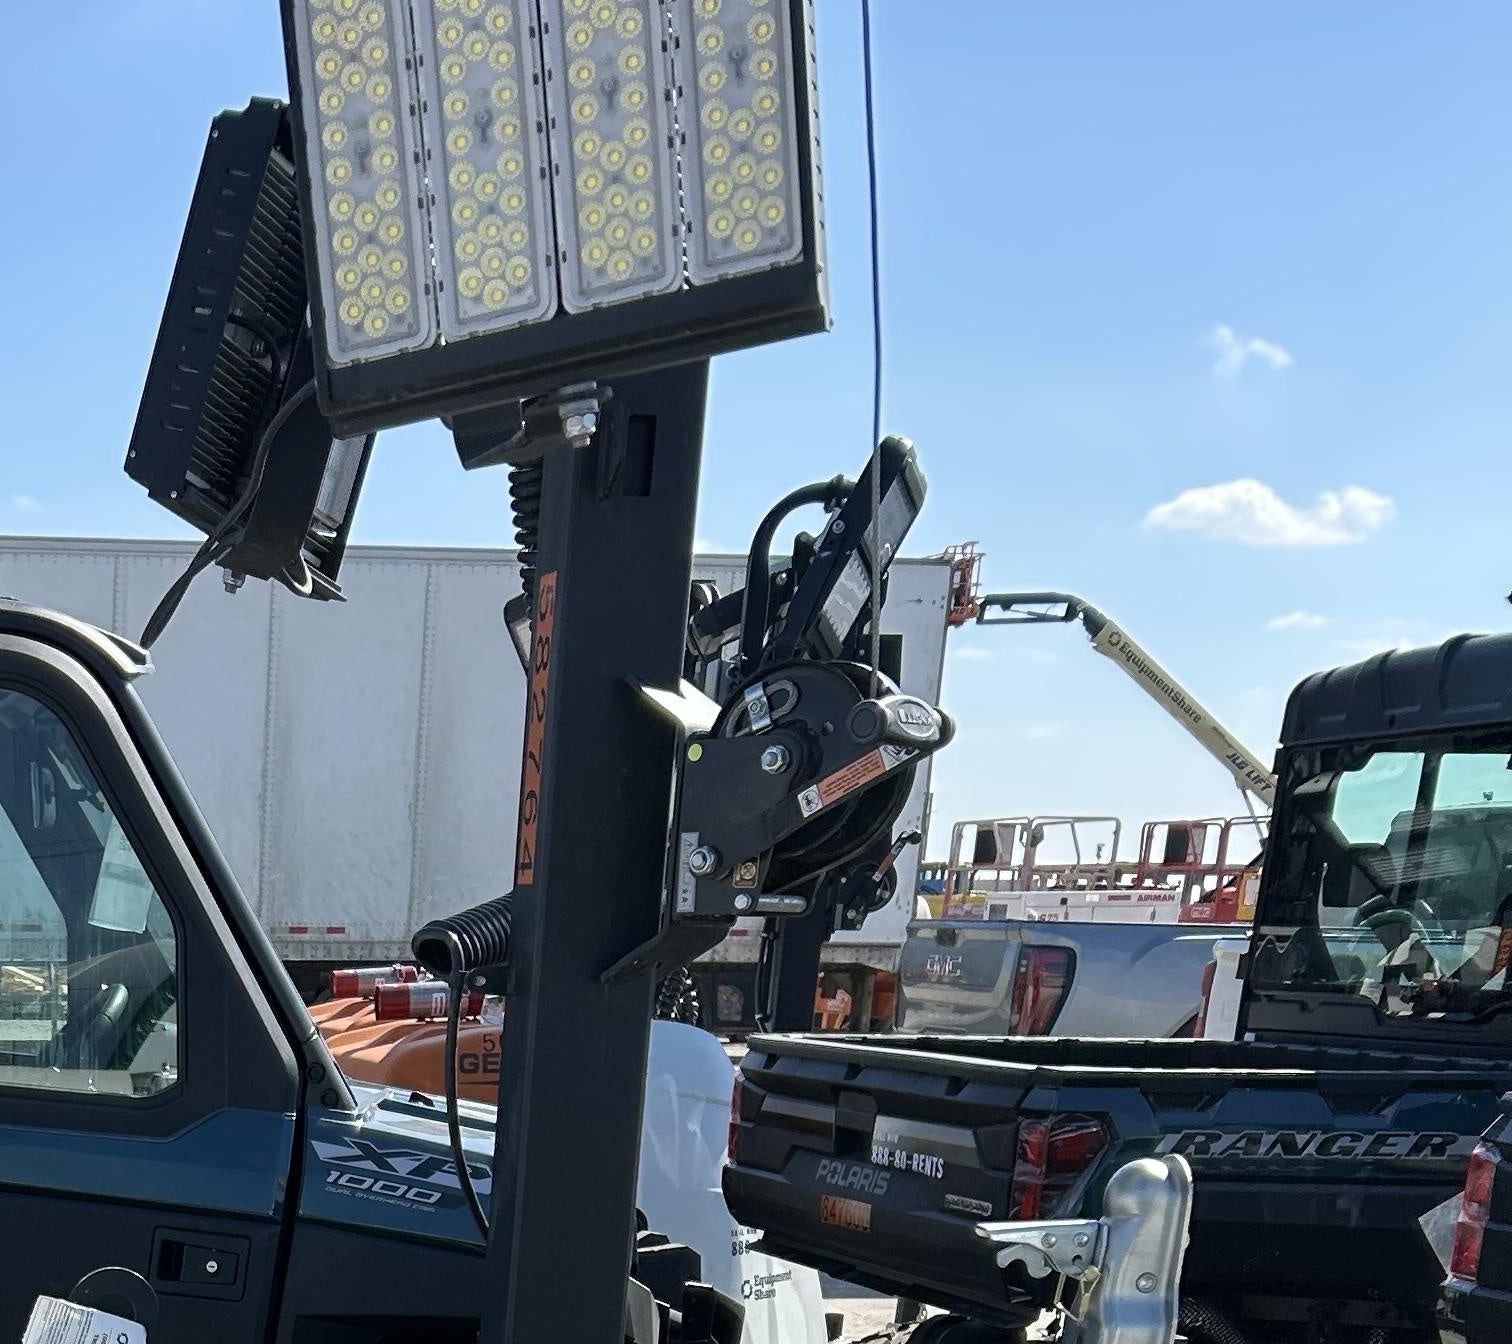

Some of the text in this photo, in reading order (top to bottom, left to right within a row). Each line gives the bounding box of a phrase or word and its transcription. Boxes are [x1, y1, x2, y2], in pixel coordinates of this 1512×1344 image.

[1119, 641, 1202, 724] EquipmentShare
[520, 584, 554, 874] 582764
[1226, 752, 1273, 792] JLG LIFT
[1137, 894, 1175, 902] AIRMAN
[926, 955, 962, 977] GMC
[321, 1137, 493, 1182] XP
[871, 1146, 945, 1179] 888-80-RENTS
[1169, 1130, 1462, 1160] RANGER
[326, 1170, 442, 1204] 1000
[816, 1159, 891, 1195] POLARIS
